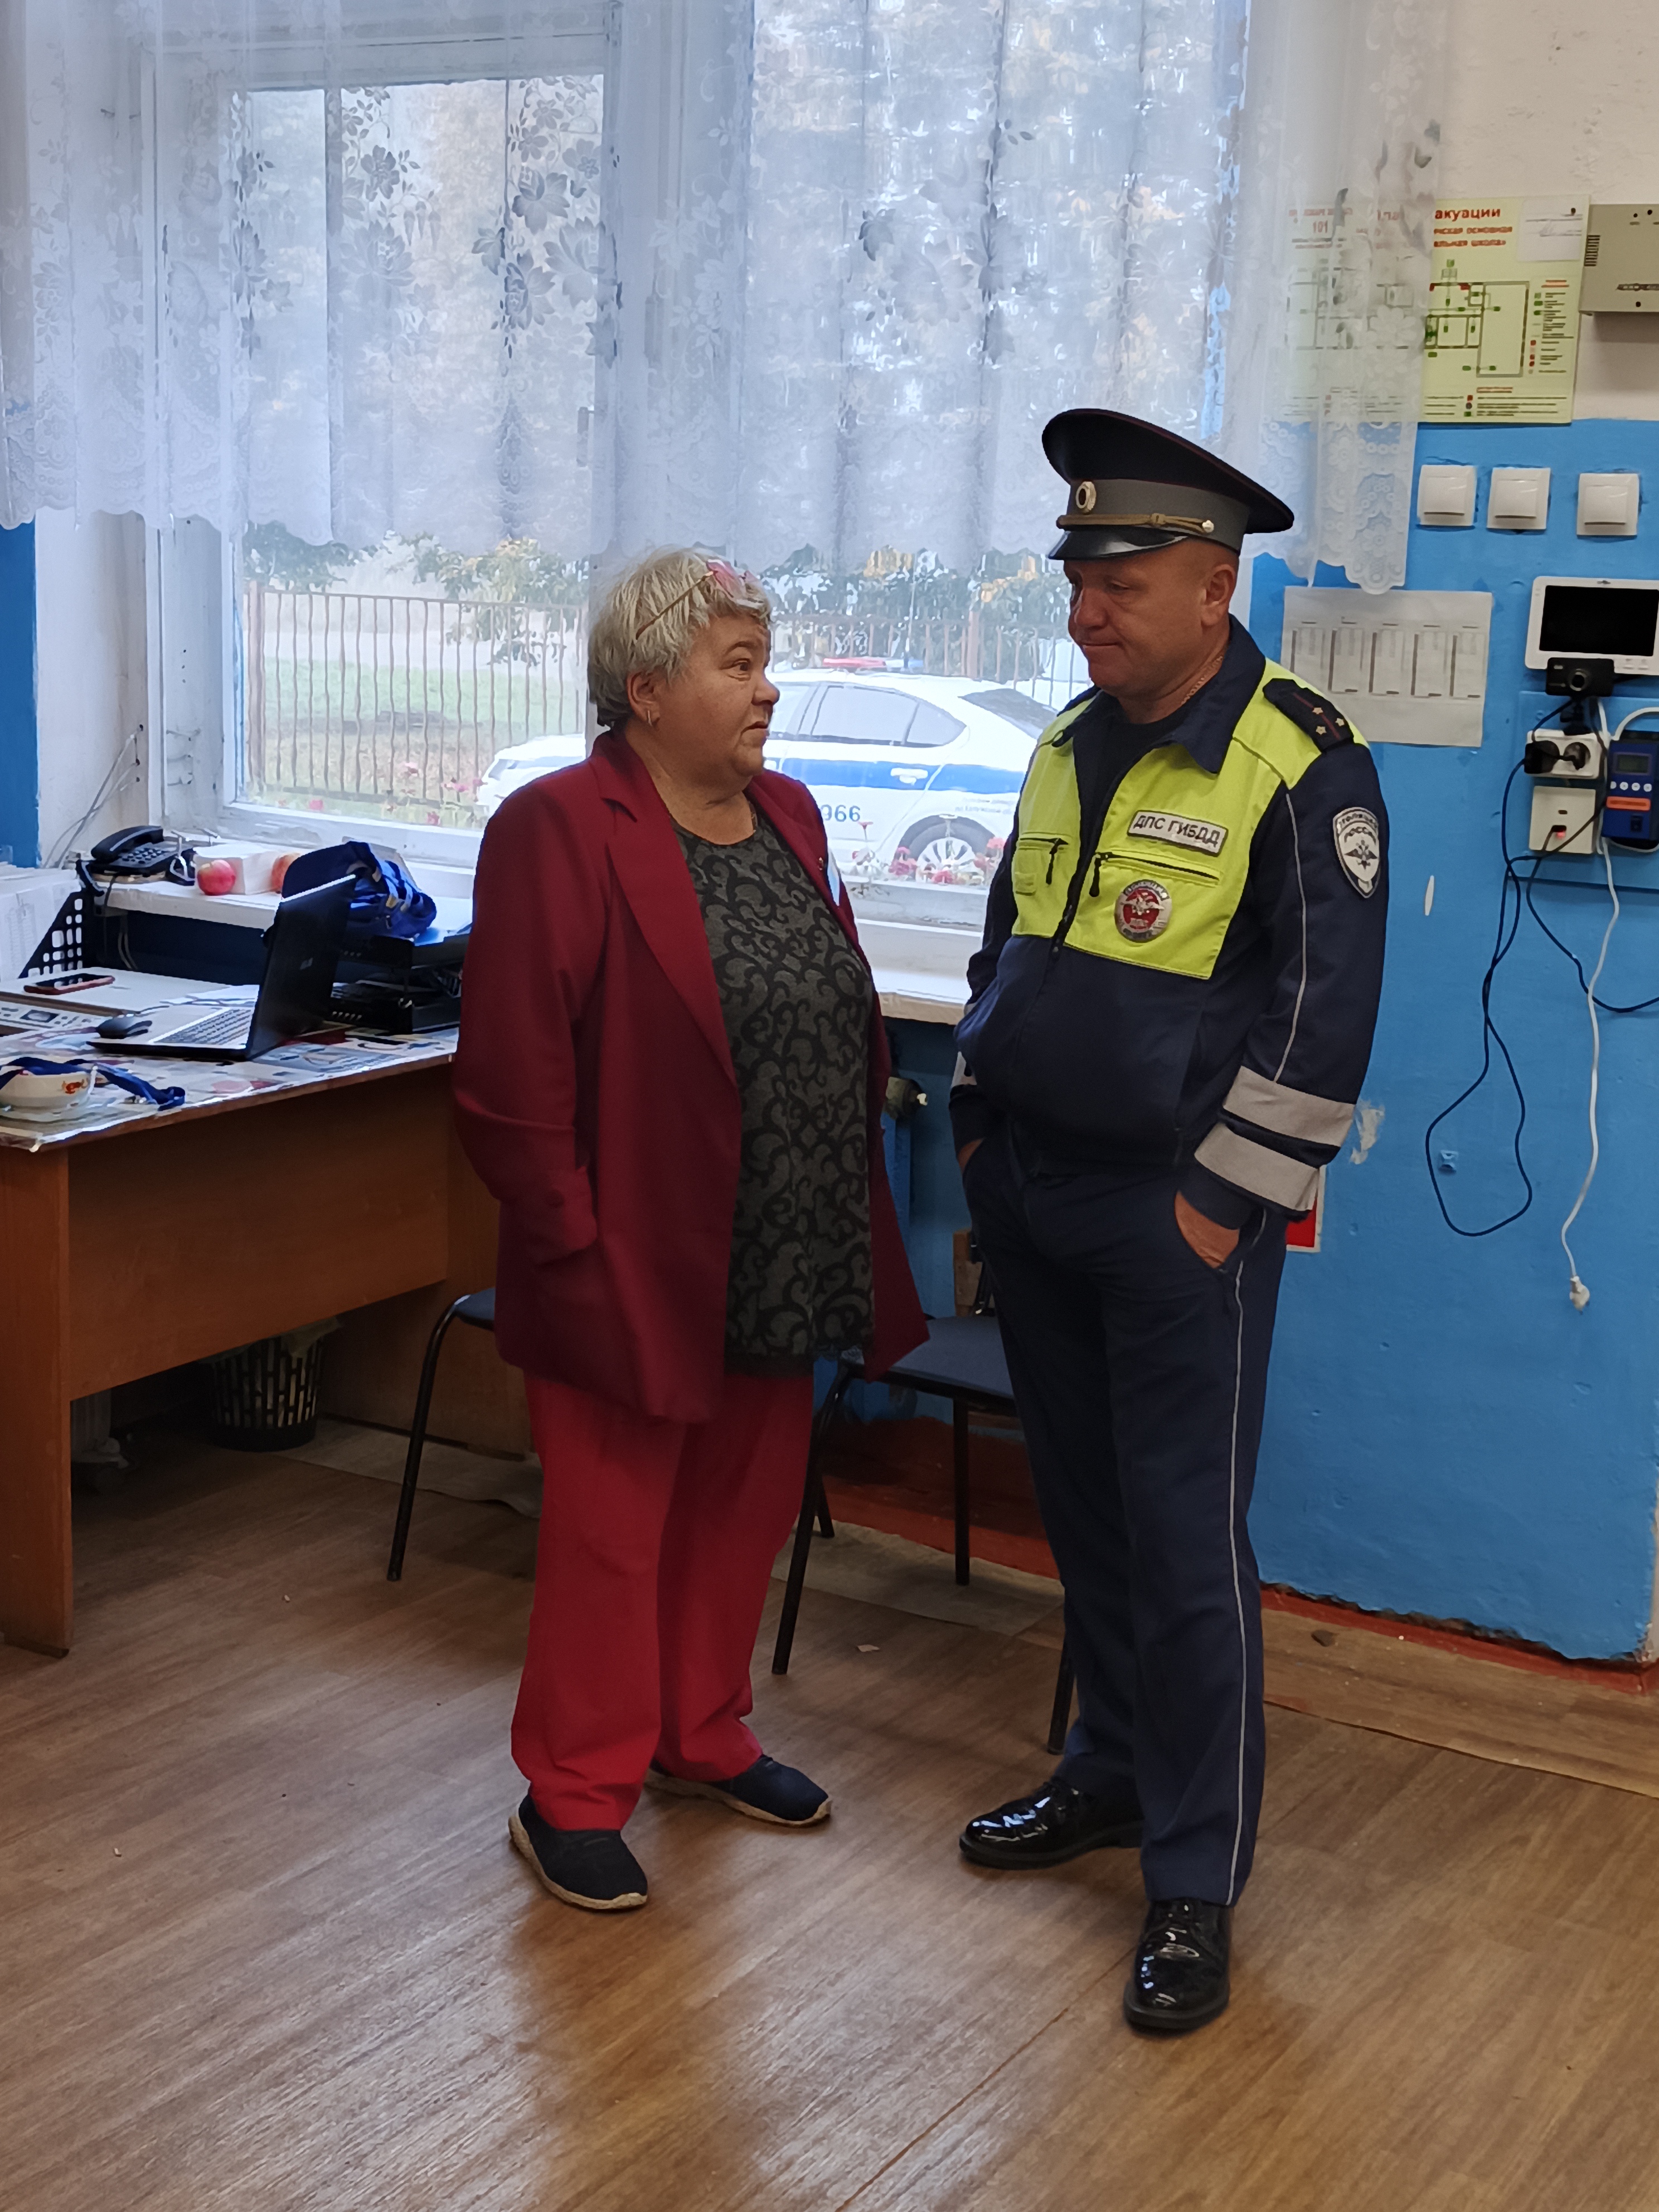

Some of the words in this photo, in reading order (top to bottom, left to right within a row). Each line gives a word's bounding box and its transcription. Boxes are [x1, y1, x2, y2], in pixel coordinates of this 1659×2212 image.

[1434, 208, 1501, 222] акуации
[1133, 814, 1166, 830] ДПС
[1167, 819, 1221, 848] ГИБДД
